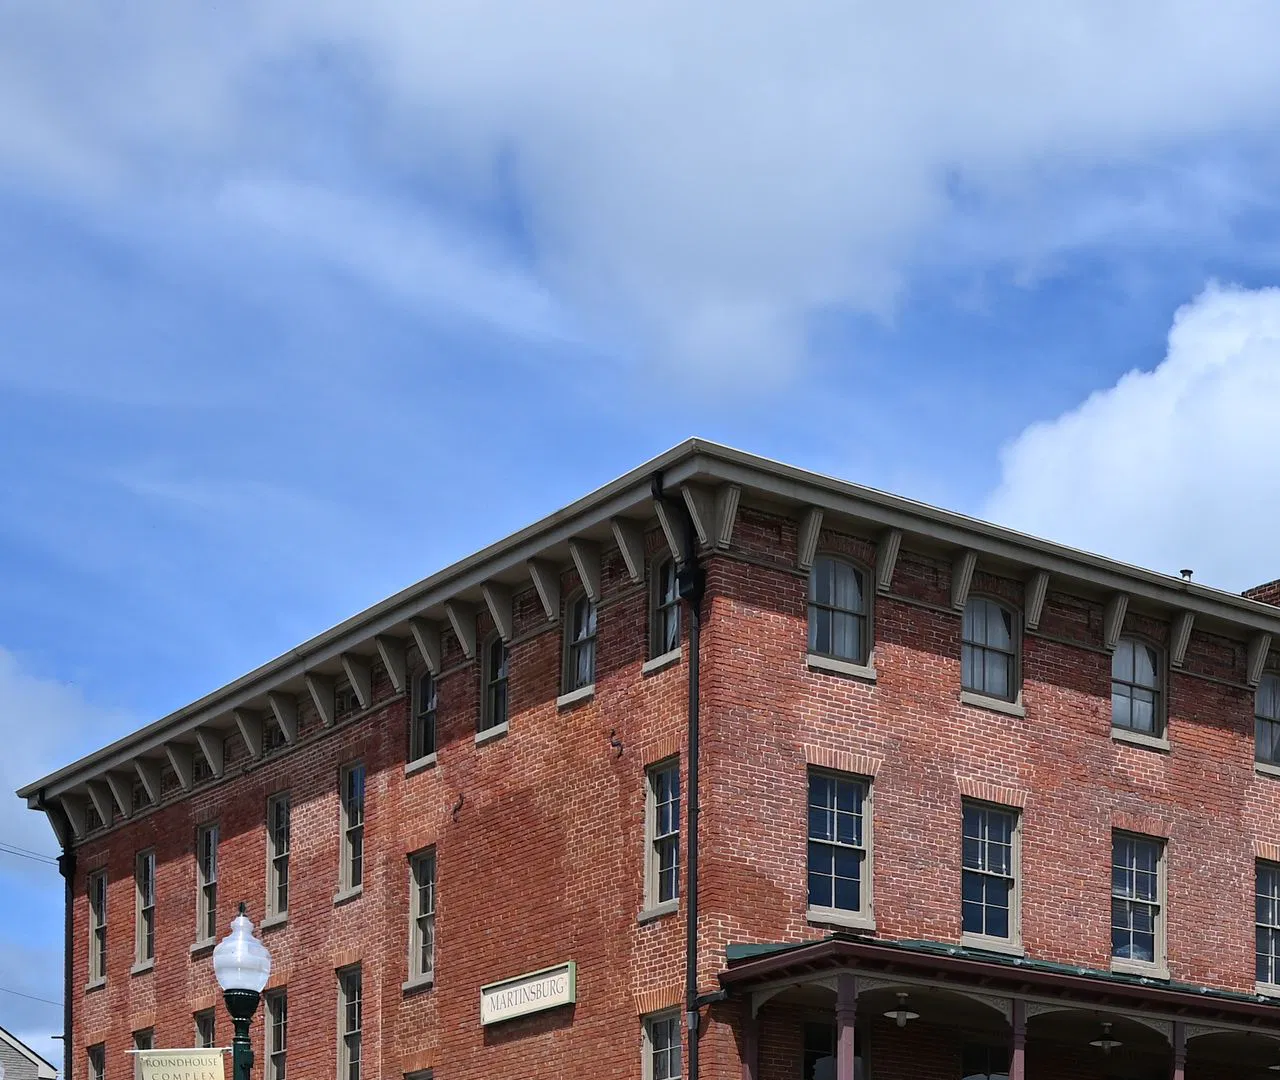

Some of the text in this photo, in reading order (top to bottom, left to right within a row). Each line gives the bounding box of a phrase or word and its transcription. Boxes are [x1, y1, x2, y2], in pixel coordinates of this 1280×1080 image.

[490, 978, 564, 1012] MARTINSBURG
[146, 1058, 217, 1068] ROUNDHOUSE
[152, 1072, 215, 1080] COMPLEX
